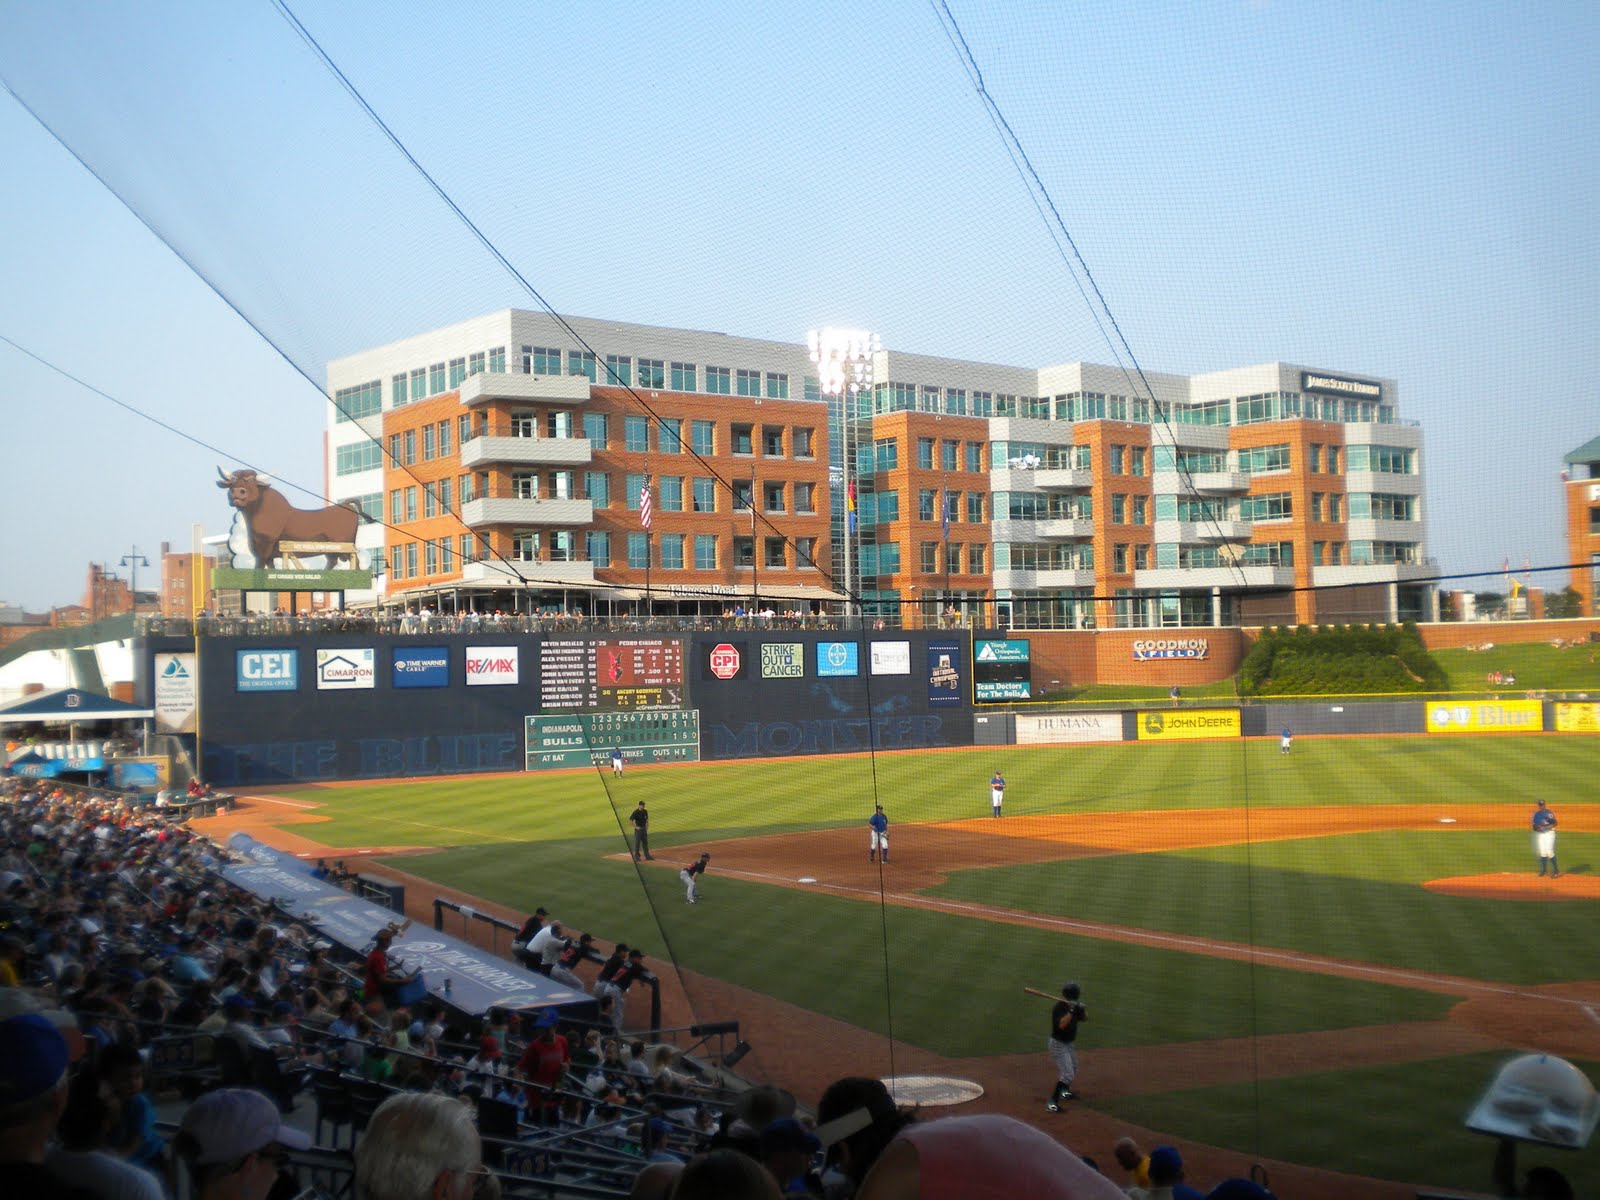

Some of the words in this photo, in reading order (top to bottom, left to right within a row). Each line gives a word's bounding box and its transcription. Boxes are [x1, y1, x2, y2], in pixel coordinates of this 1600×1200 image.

[669, 585, 711, 597] Tobacco
[711, 585, 737, 596] Road
[762, 645, 794, 655] STRIKE
[1133, 639, 1207, 650] GOODMON
[242, 654, 291, 679] CEI
[466, 658, 514, 674] RE/MAX
[713, 656, 736, 667] CPI
[763, 656, 784, 666] OUT
[326, 669, 372, 677] CIMARRON
[763, 665, 802, 676] CANCER
[996, 682, 1022, 690] Doctors
[1478, 705, 1535, 726] Blue
[1038, 718, 1101, 730] HUMANA
[1168, 717, 1197, 729] JOHN
[1198, 716, 1232, 728] DEERE
[542, 725, 583, 733] INDIANAPOLIS
[543, 737, 582, 746] BULLS
[708, 716, 945, 757] MONSTER
